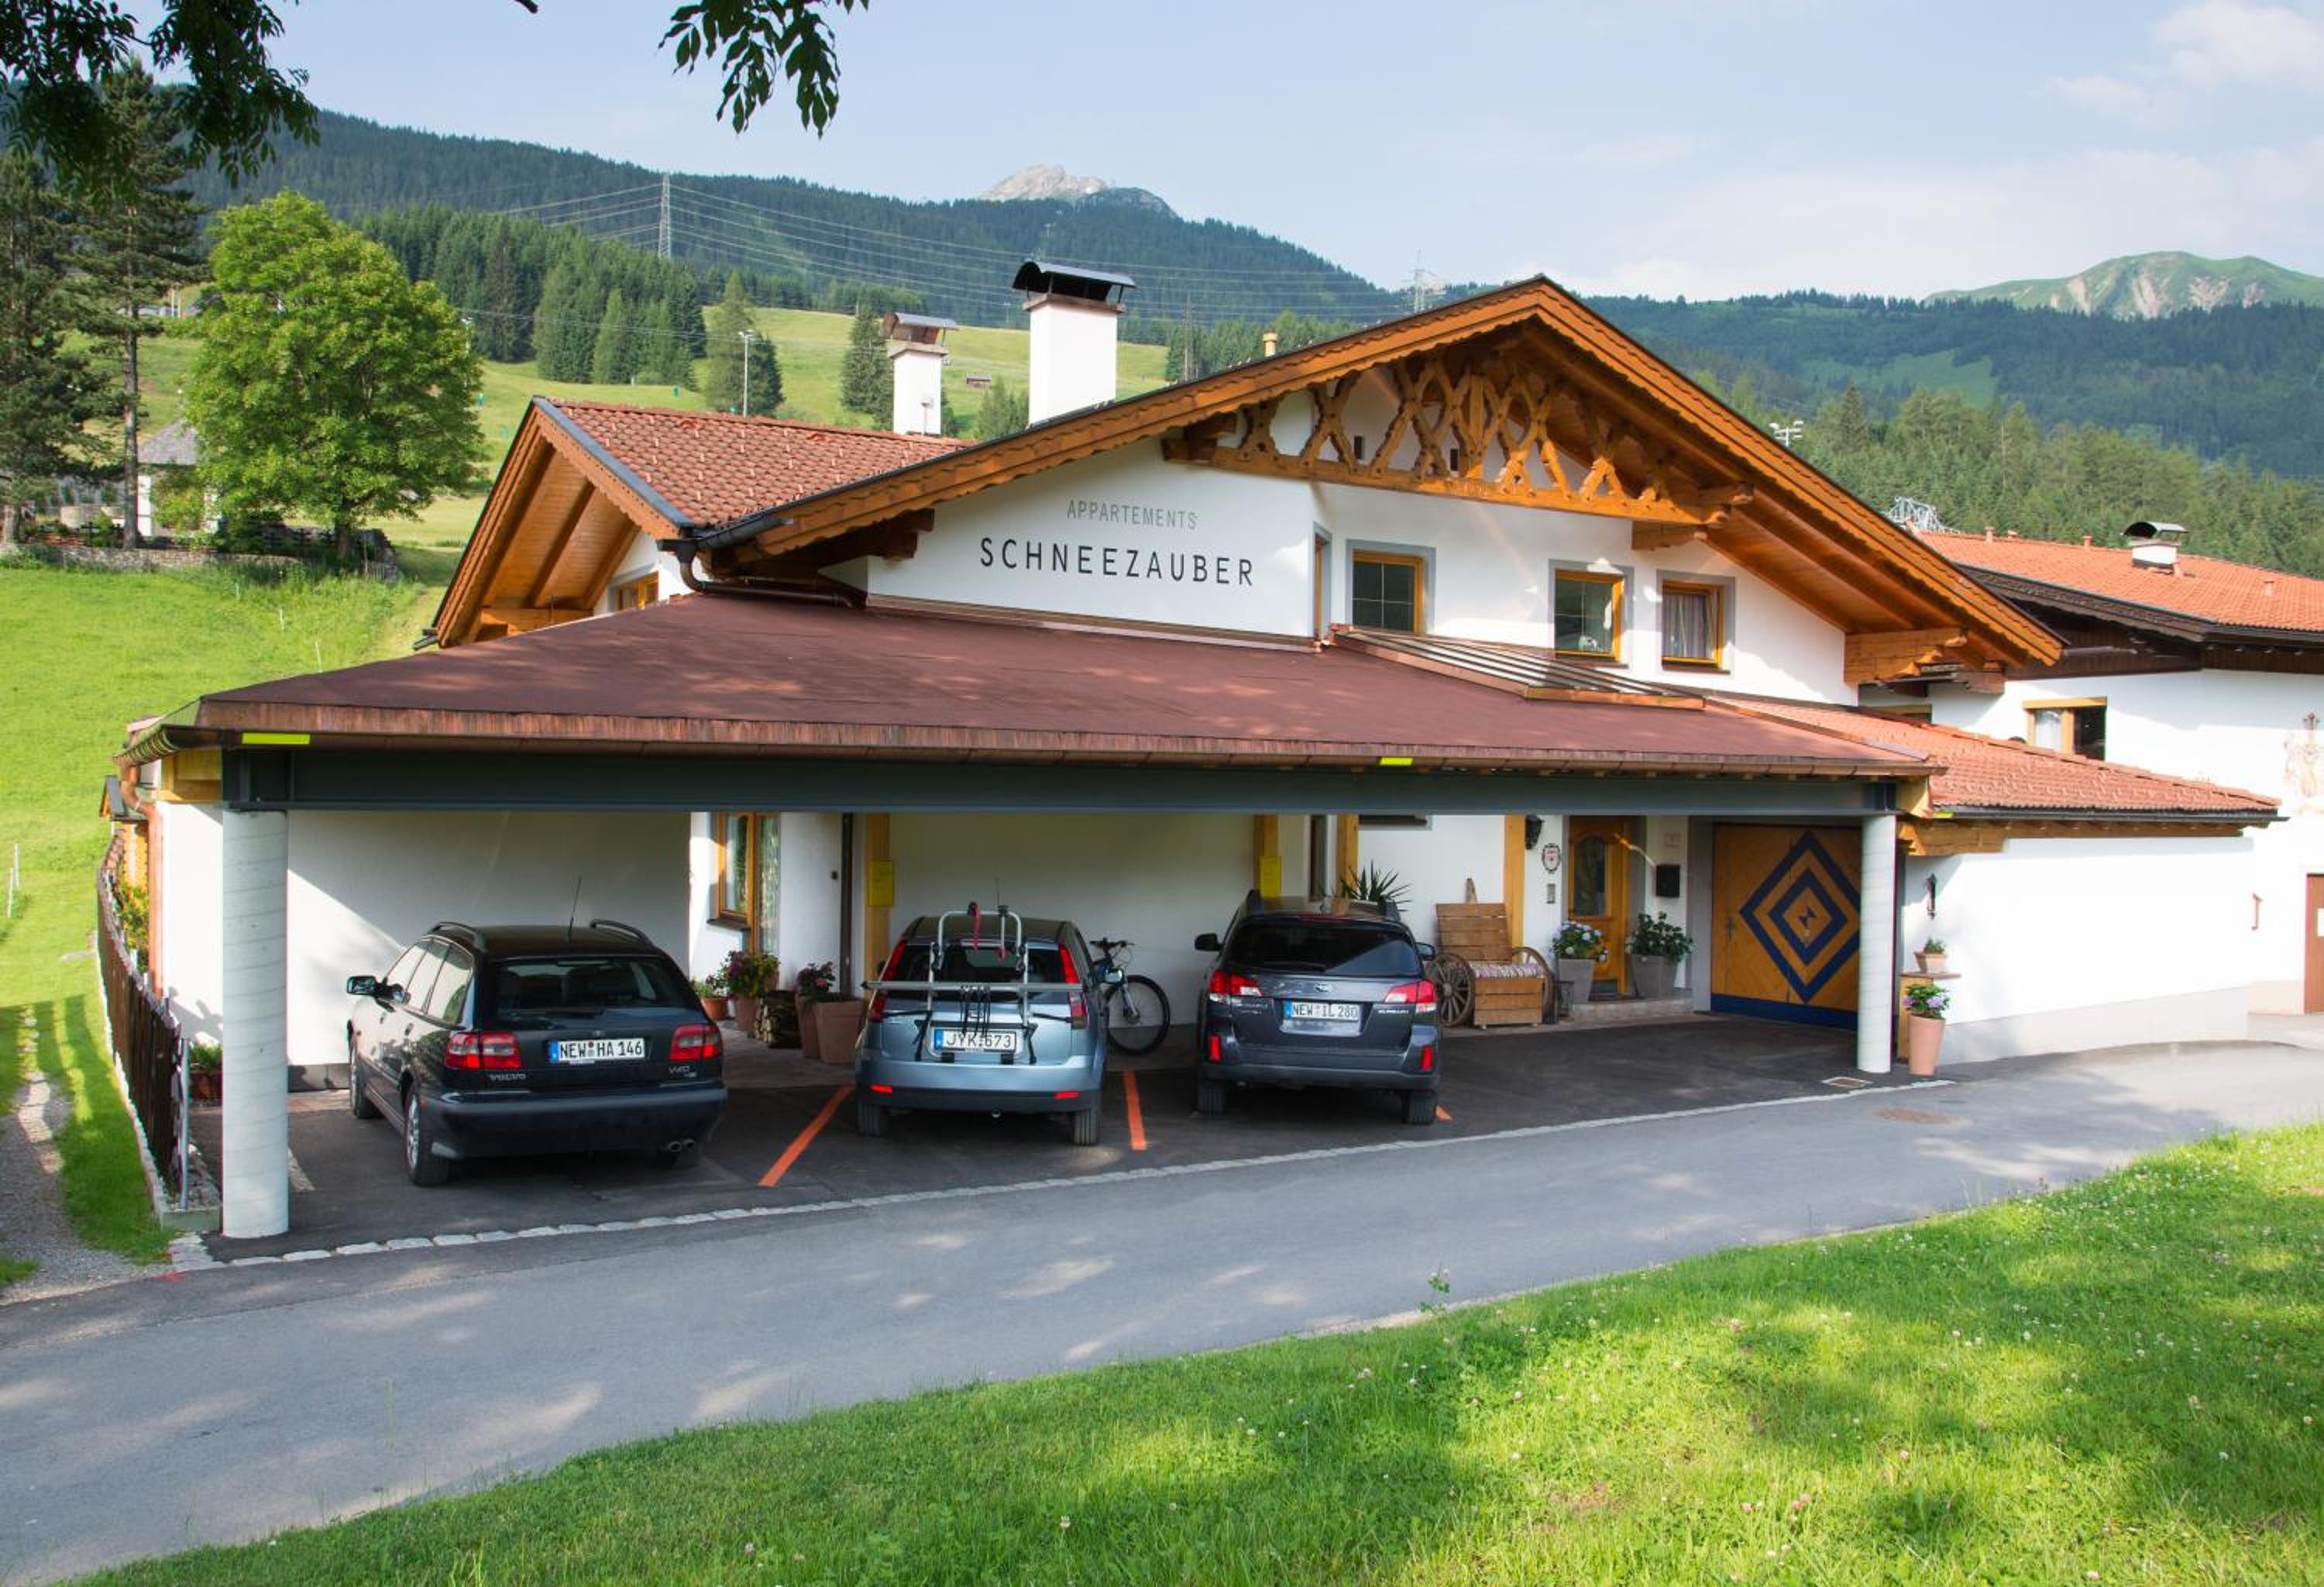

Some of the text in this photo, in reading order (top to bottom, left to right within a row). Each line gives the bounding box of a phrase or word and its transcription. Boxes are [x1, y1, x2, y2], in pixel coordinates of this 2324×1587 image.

[1067, 500, 1198, 530] APPARTEMENTS
[980, 538, 1253, 586] SCHNEEZAUBER
[1293, 1004, 1313, 1016] NEW
[560, 1041, 642, 1059] NEW HA 146
